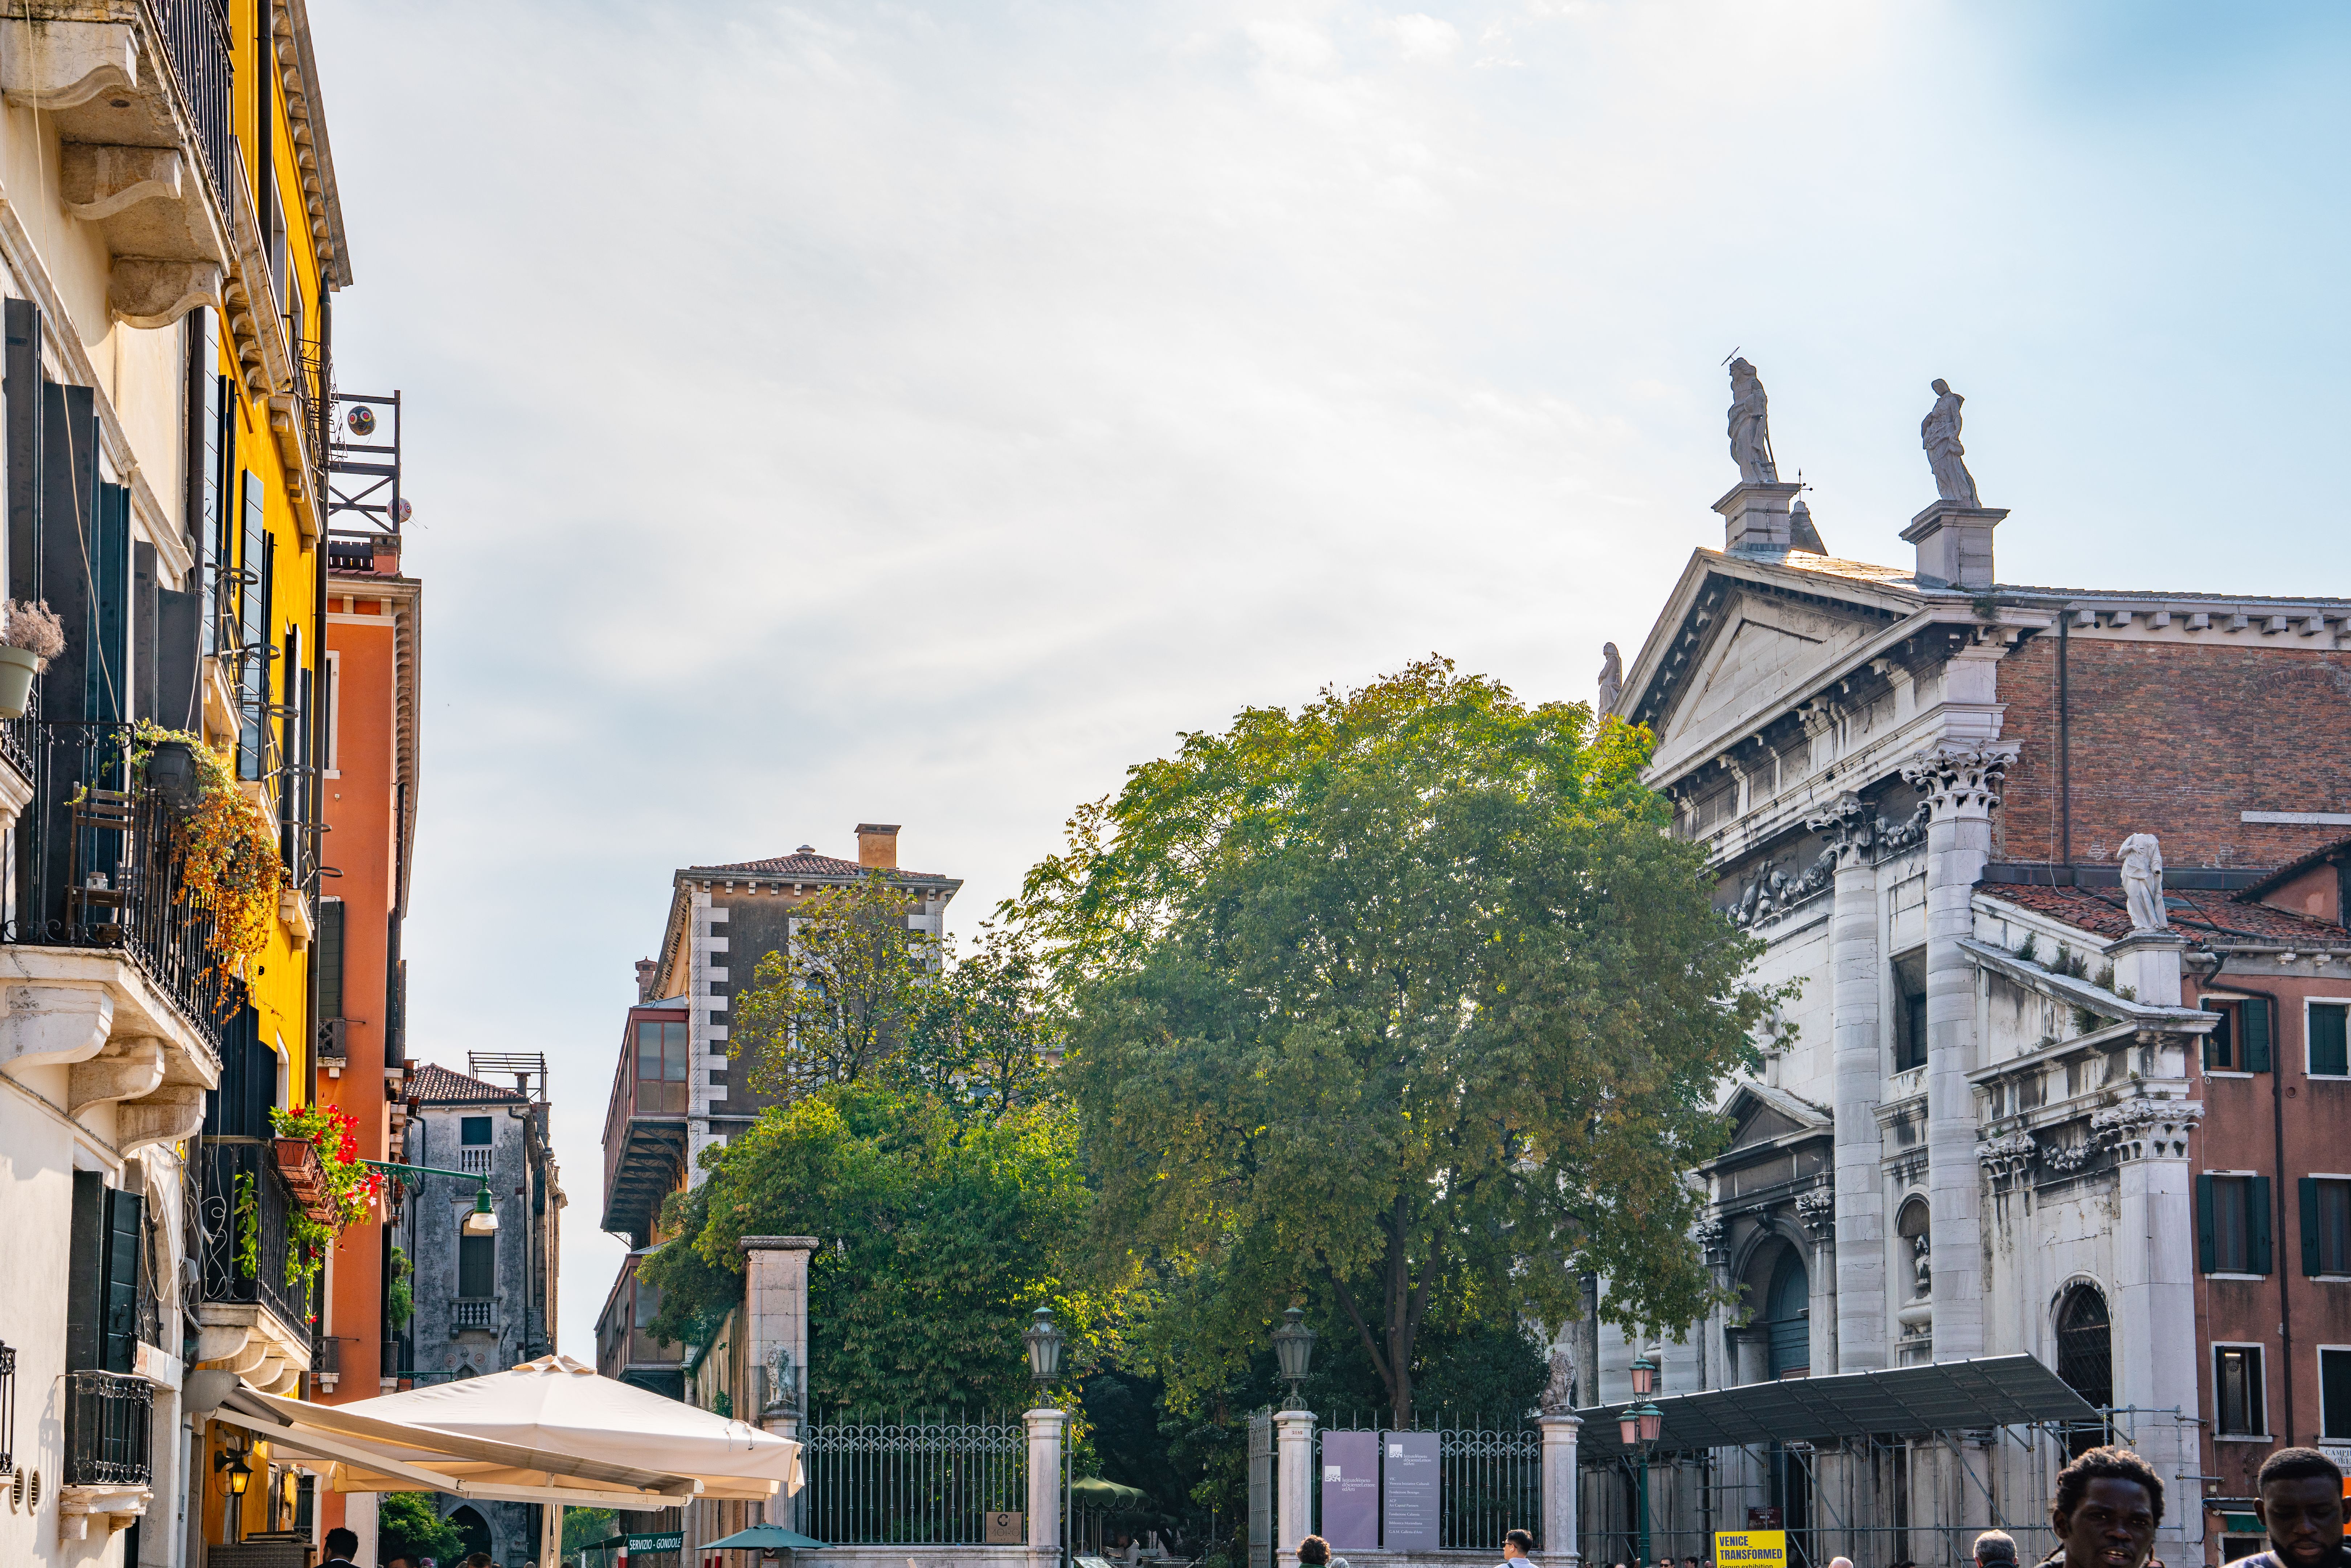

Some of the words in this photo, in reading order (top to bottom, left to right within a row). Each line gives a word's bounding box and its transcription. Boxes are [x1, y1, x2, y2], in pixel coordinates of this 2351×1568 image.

[138, 1351, 148, 1367] 2807
[630, 1539, 652, 1550] SERVIZIO
[656, 1538, 681, 1549] GONDOLE
[1720, 1549, 1783, 1560] TRANSFORMED
